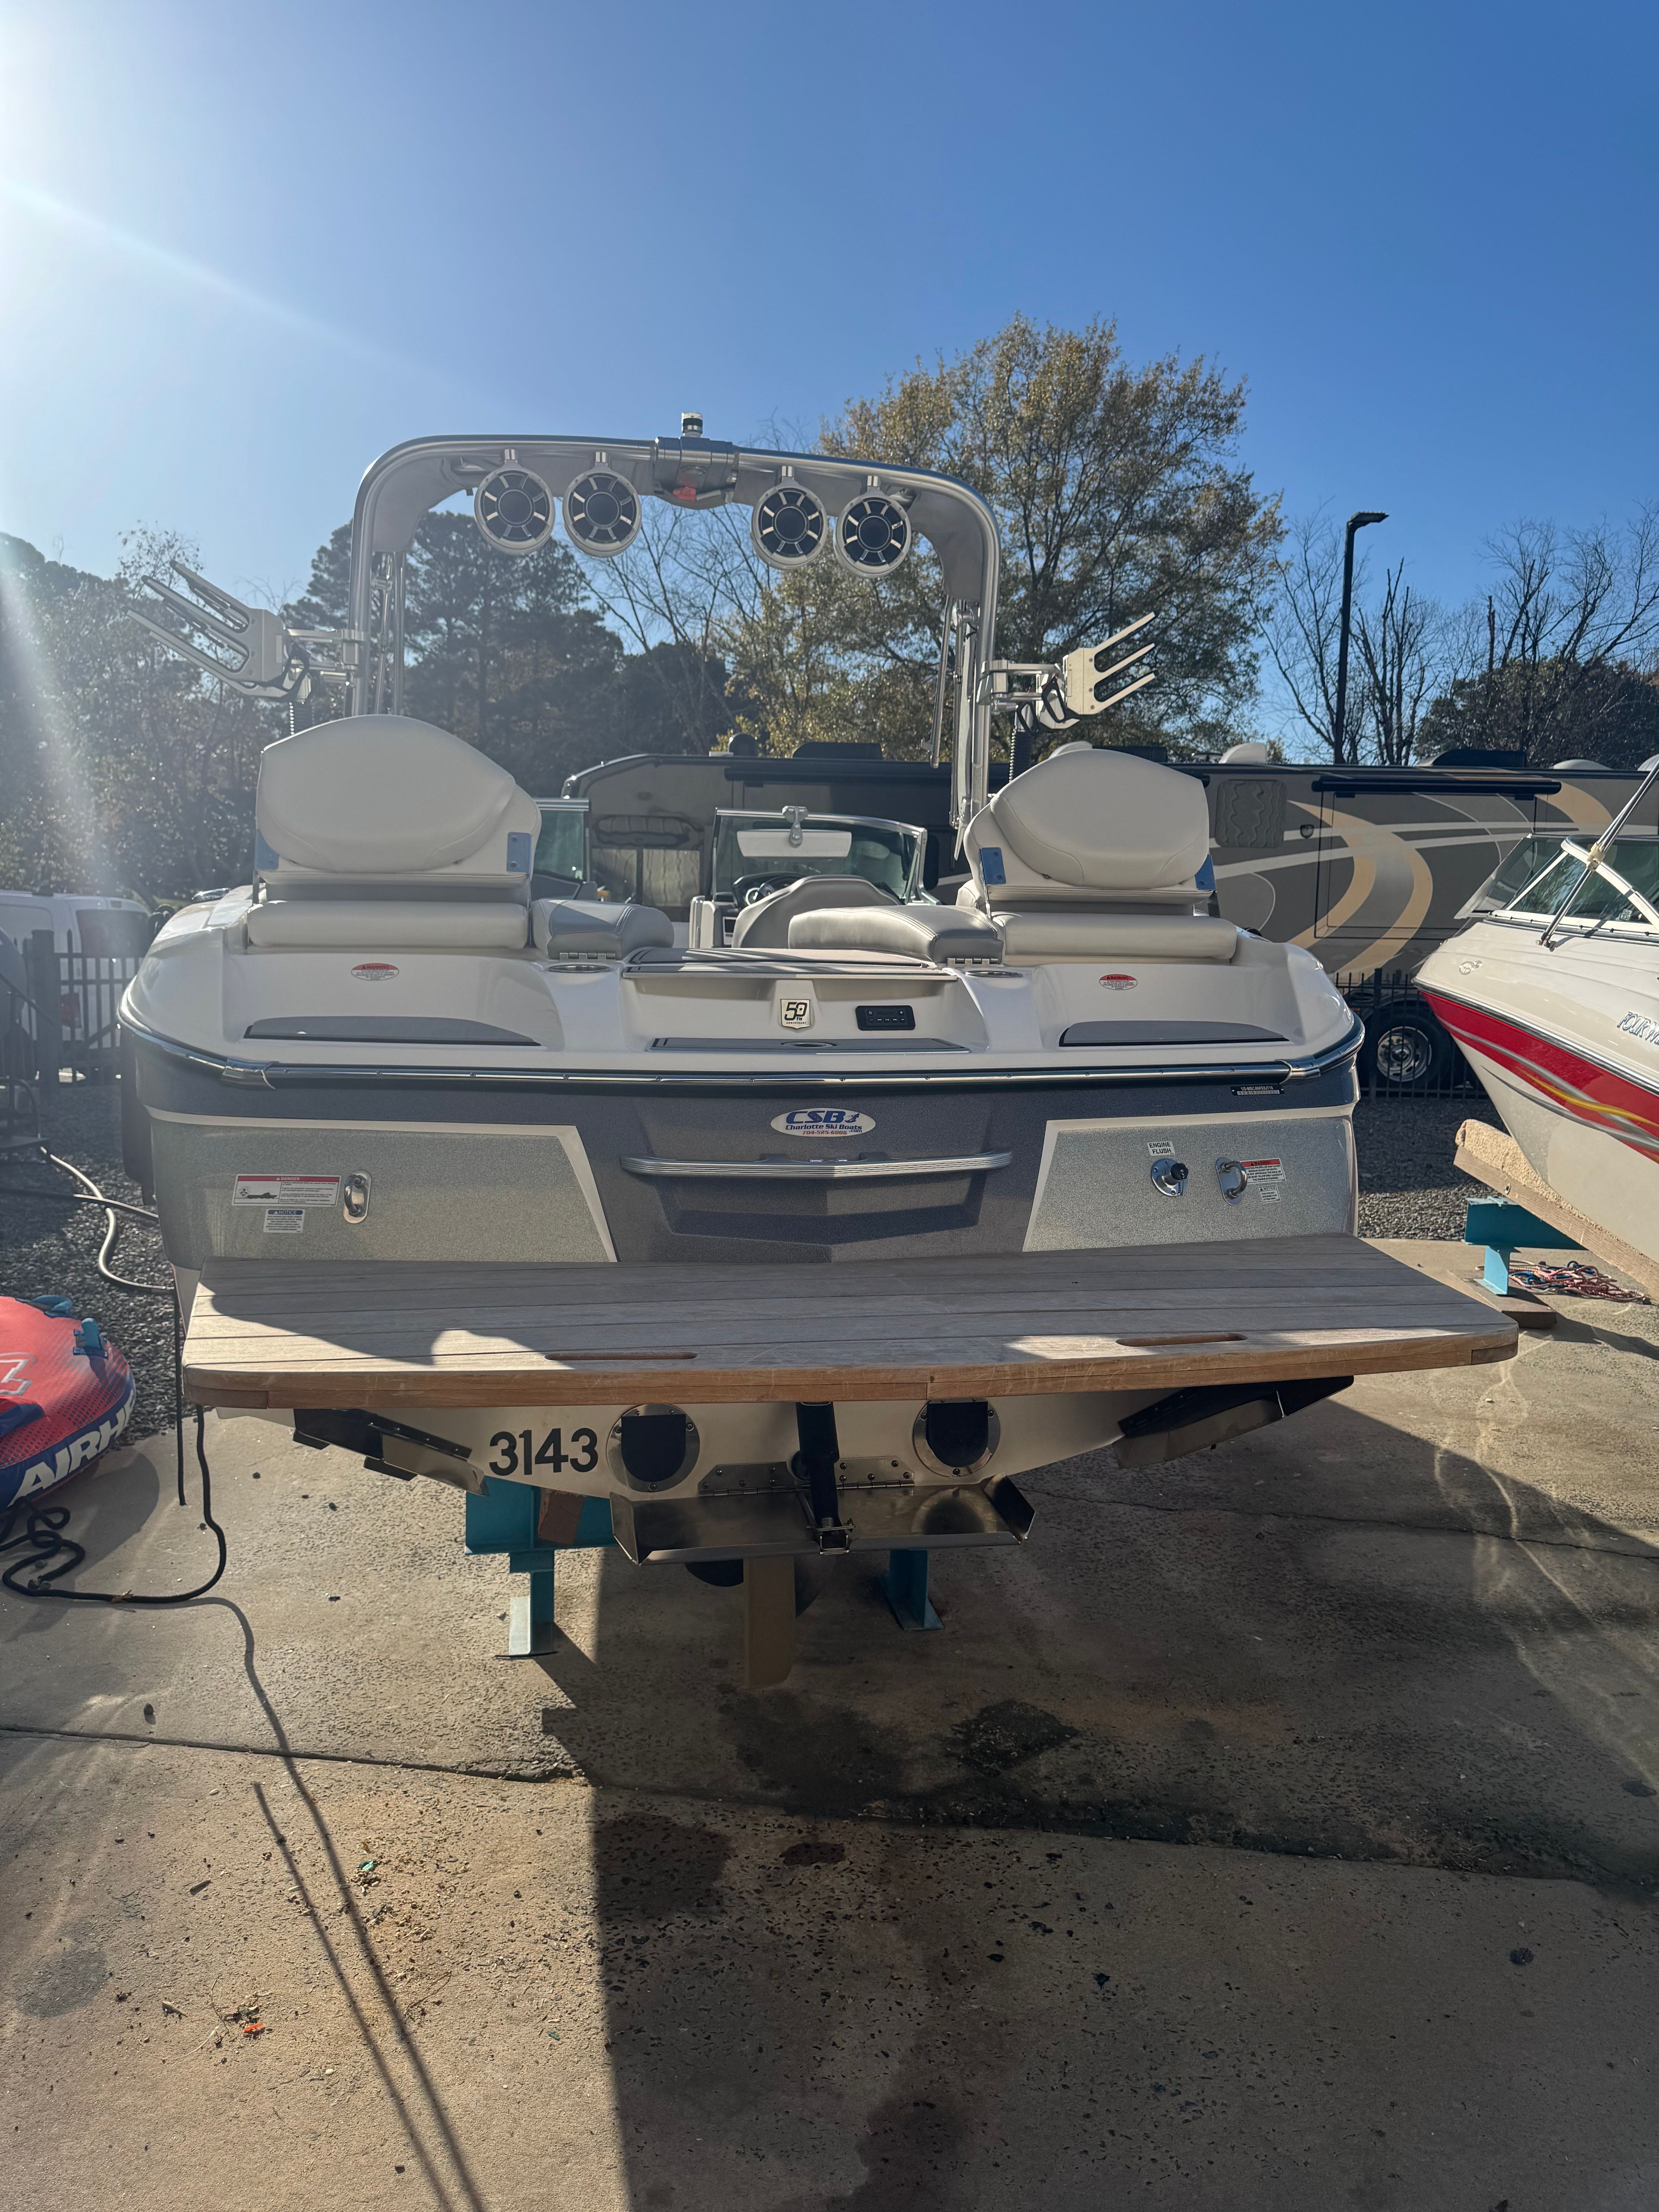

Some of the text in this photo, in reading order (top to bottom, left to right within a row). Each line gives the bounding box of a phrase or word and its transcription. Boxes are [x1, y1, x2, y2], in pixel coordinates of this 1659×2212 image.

[1617, 1011, 1651, 1038] FOUR
[786, 1111, 846, 1124] CSB
[489, 1427, 599, 1476] 3143
